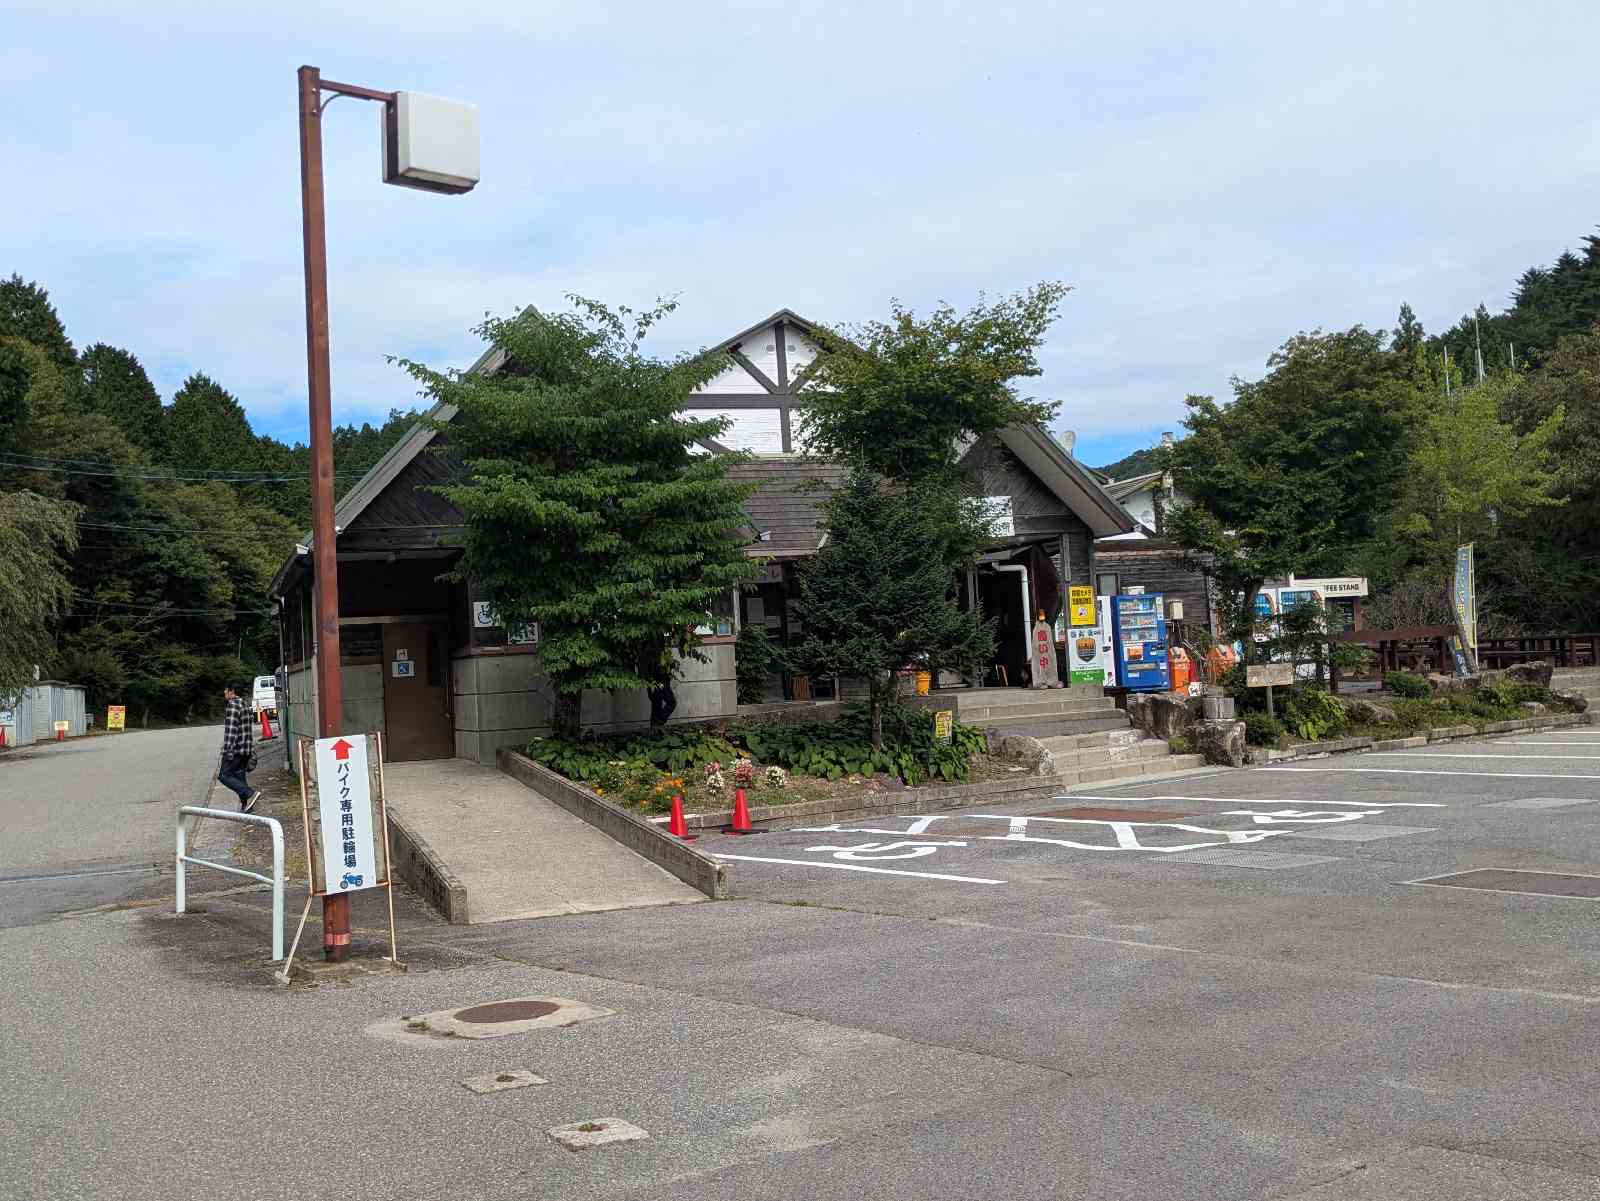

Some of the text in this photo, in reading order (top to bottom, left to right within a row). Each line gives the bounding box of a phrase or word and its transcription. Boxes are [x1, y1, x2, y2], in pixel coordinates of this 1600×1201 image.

[1338, 583, 1360, 592] STAND
[337, 762, 357, 868] バイク専用駐輪場
